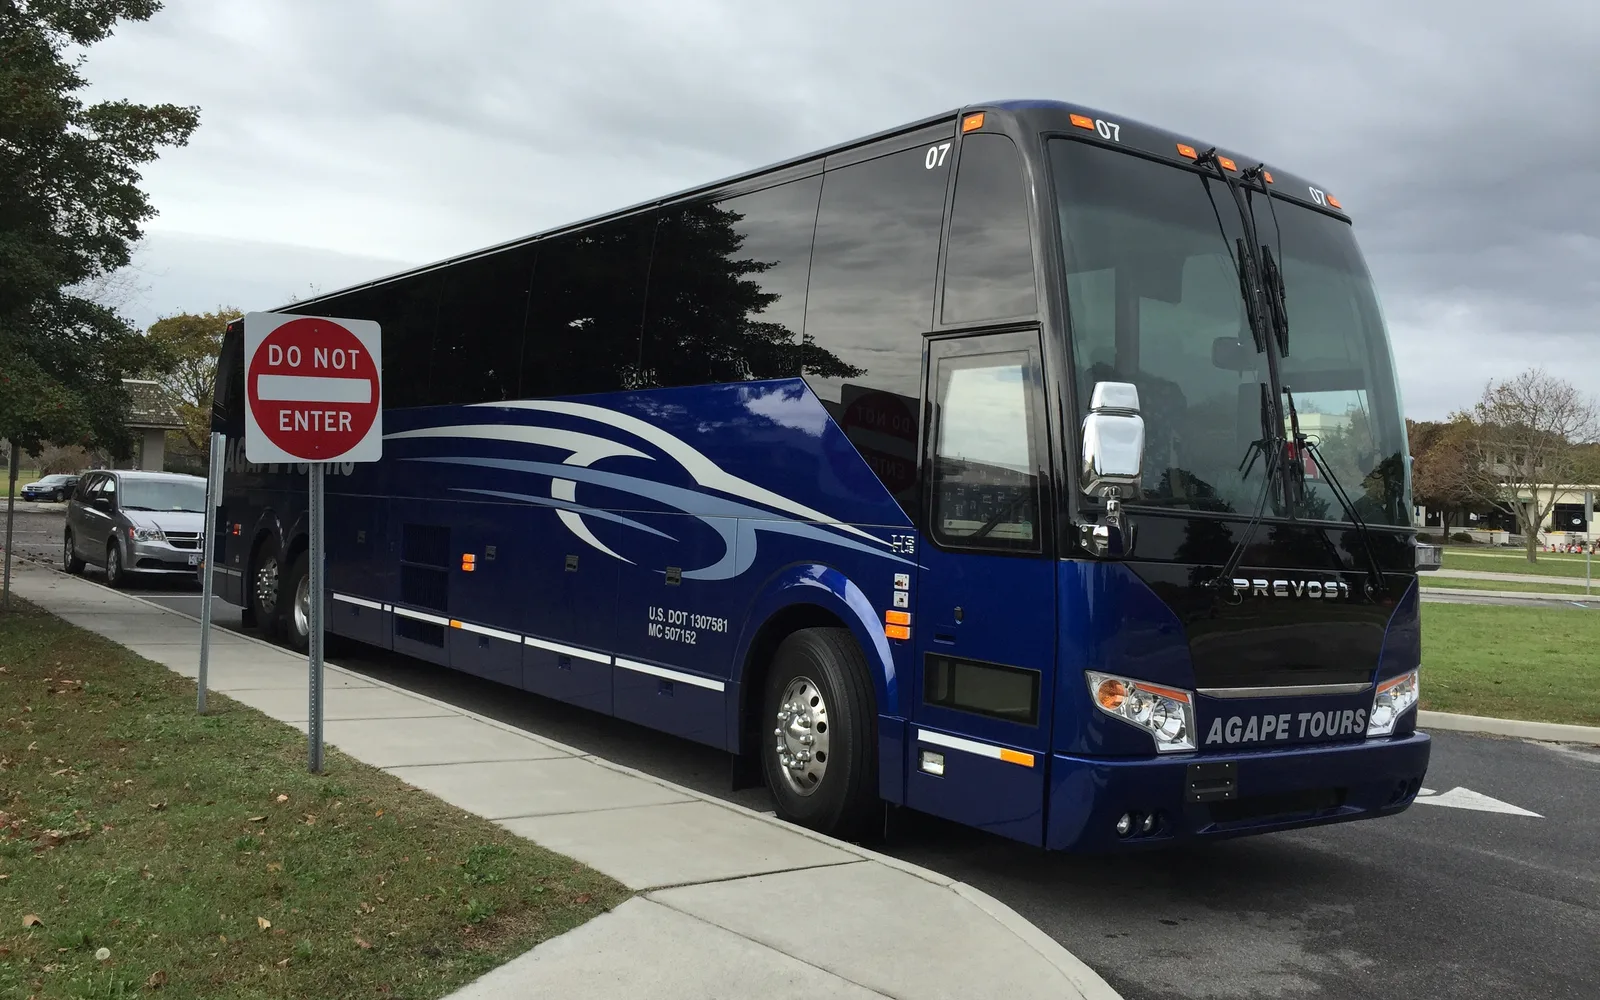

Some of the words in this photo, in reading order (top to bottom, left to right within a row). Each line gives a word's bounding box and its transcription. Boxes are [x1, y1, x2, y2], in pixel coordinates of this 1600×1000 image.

[1095, 119, 1120, 142] 07
[925, 143, 951, 170] 07
[1308, 186, 1327, 206] 07
[268, 344, 302, 367] DO
[314, 347, 360, 370] NOT
[279, 409, 353, 432] ENTER
[1232, 578, 1352, 598] PREVOST
[649, 606, 666, 622] U.S.
[668, 609, 688, 626] DOT
[690, 613, 728, 633] 1307581
[648, 622, 663, 638] MC
[664, 626, 697, 645] 507152
[1205, 713, 1292, 745] AGAPE
[1298, 708, 1367, 739] TOURS
